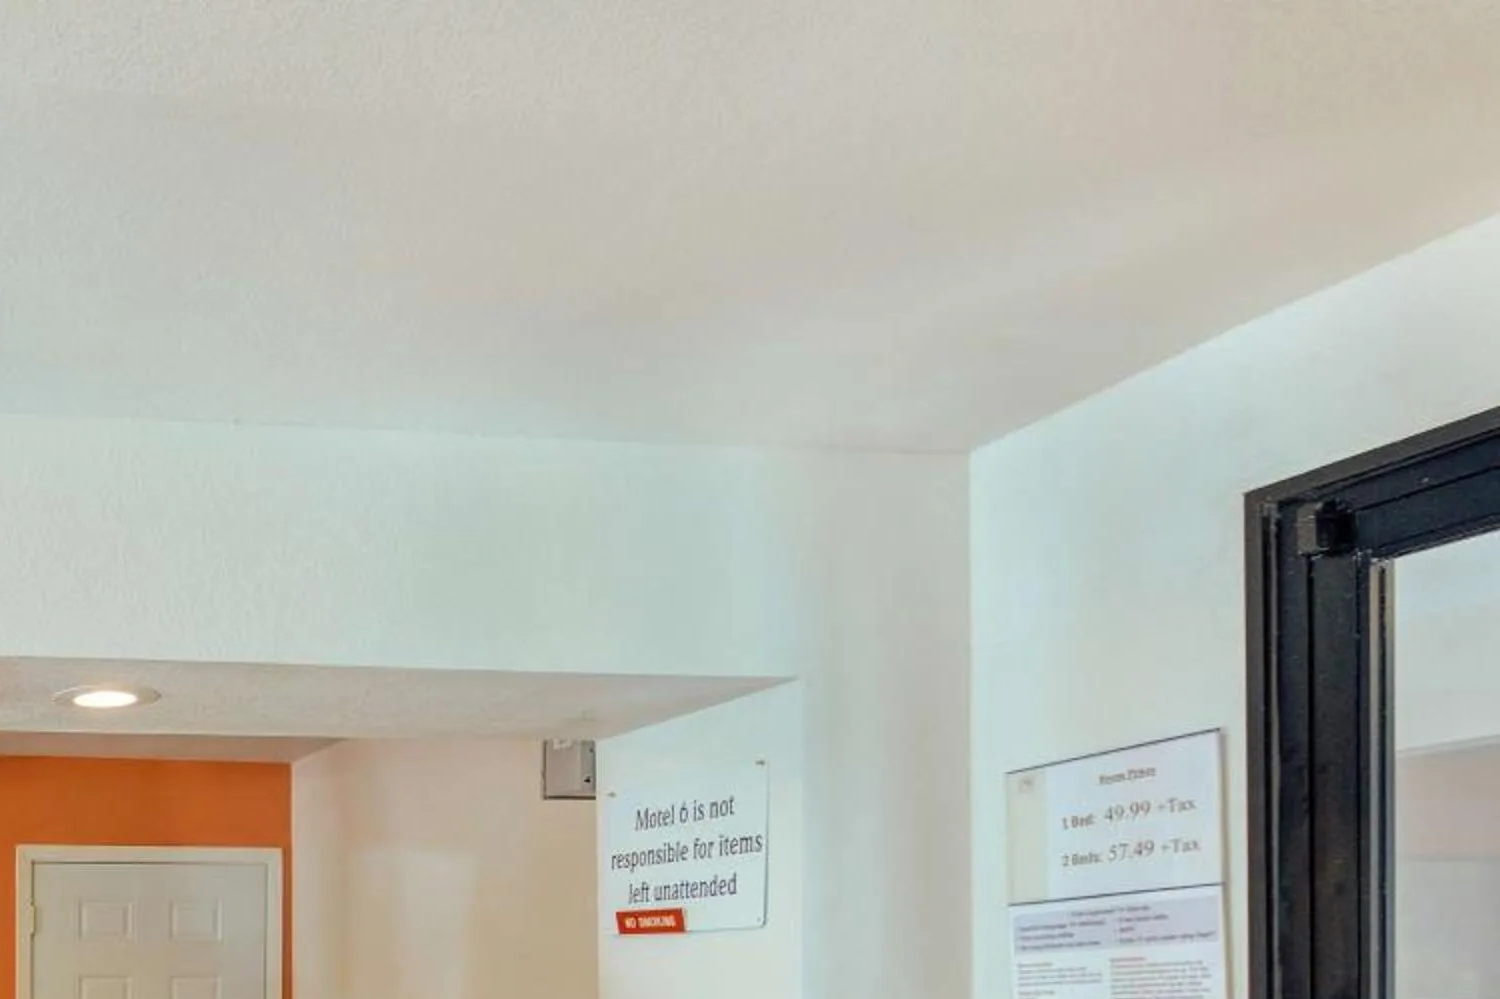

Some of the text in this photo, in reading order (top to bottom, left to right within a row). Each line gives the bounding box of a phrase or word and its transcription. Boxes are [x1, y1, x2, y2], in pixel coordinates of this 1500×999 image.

[634, 795, 735, 831] Motel 6 is not
[1104, 801, 1152, 823] 49.99
[611, 834, 763, 873] responsible for items
[1062, 855, 1070, 867] 2
[1107, 840, 1155, 862] 57.49
[628, 872, 737, 905] left unattended
